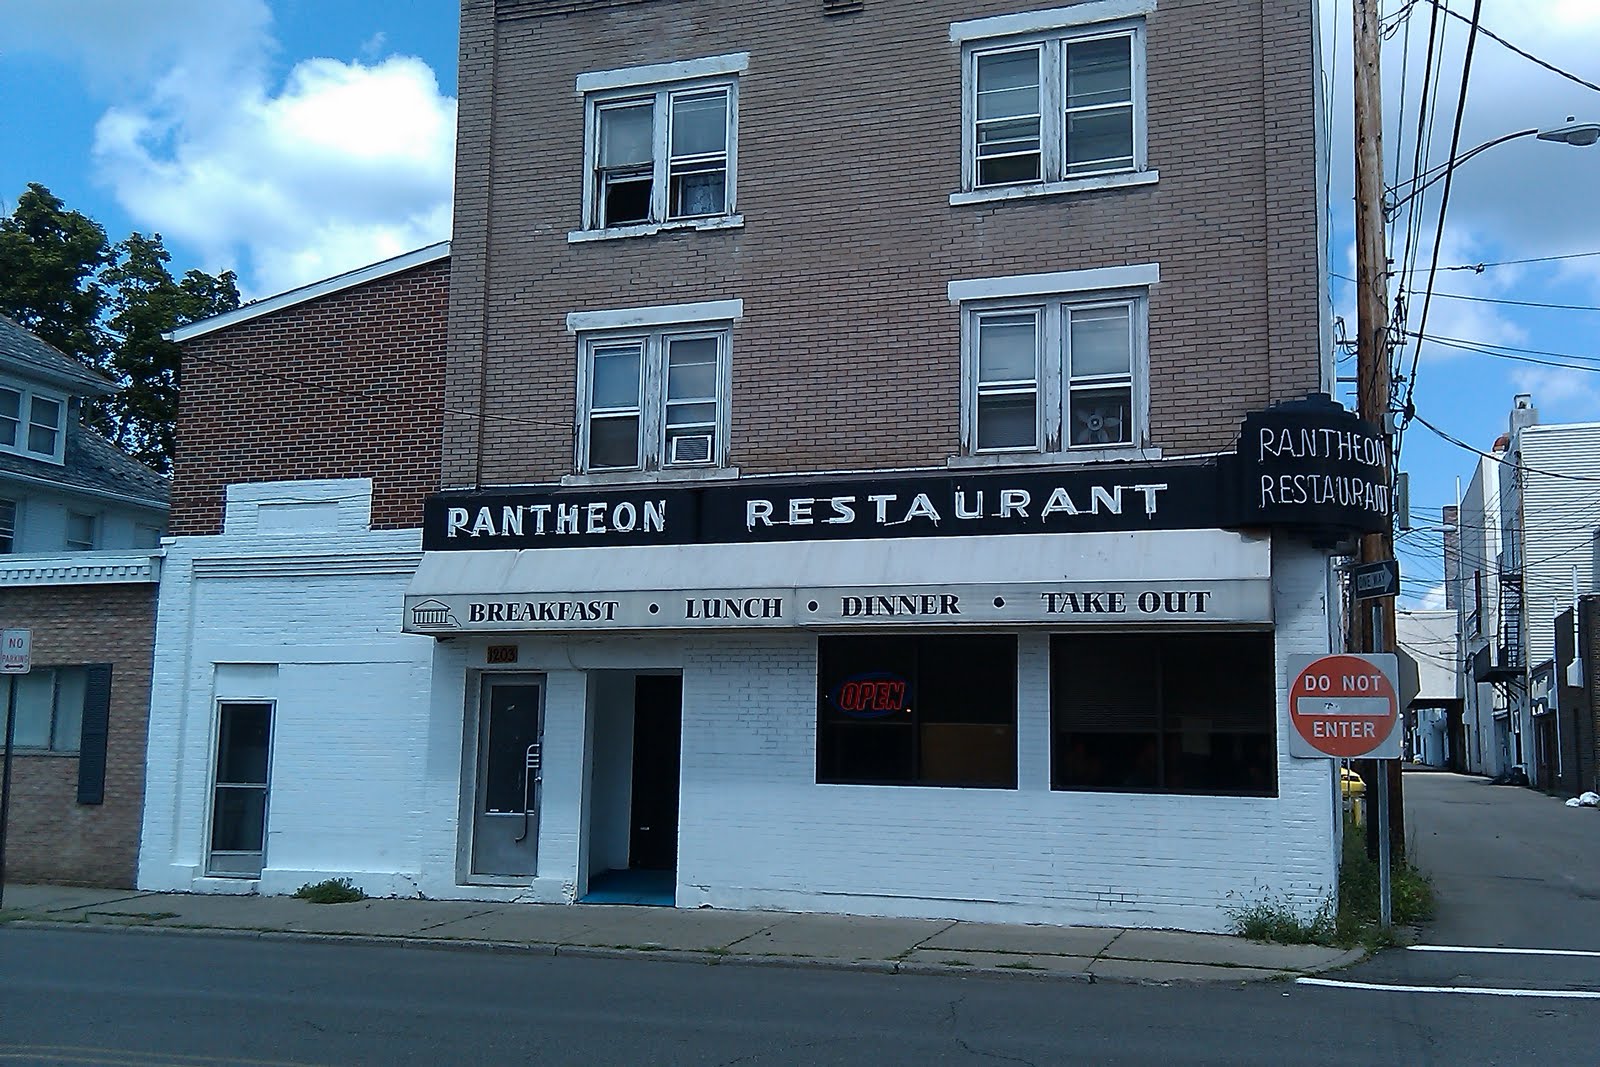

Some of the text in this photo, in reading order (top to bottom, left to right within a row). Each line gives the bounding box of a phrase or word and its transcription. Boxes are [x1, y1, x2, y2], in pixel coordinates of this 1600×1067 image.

[1259, 474, 1389, 516] RESTAURANT
[746, 483, 1168, 532] RESTAURANT
[1359, 571, 1385, 589] ONE WAY
[468, 590, 1212, 622] BREAKFAST LUNCH DINNER TAKE OUT
[8, 637, 24, 649] NO
[488, 647, 516, 661] 1203
[1304, 675, 1381, 691] DO NOT
[841, 682, 905, 711] OPEN
[1313, 721, 1375, 738] ENTER
